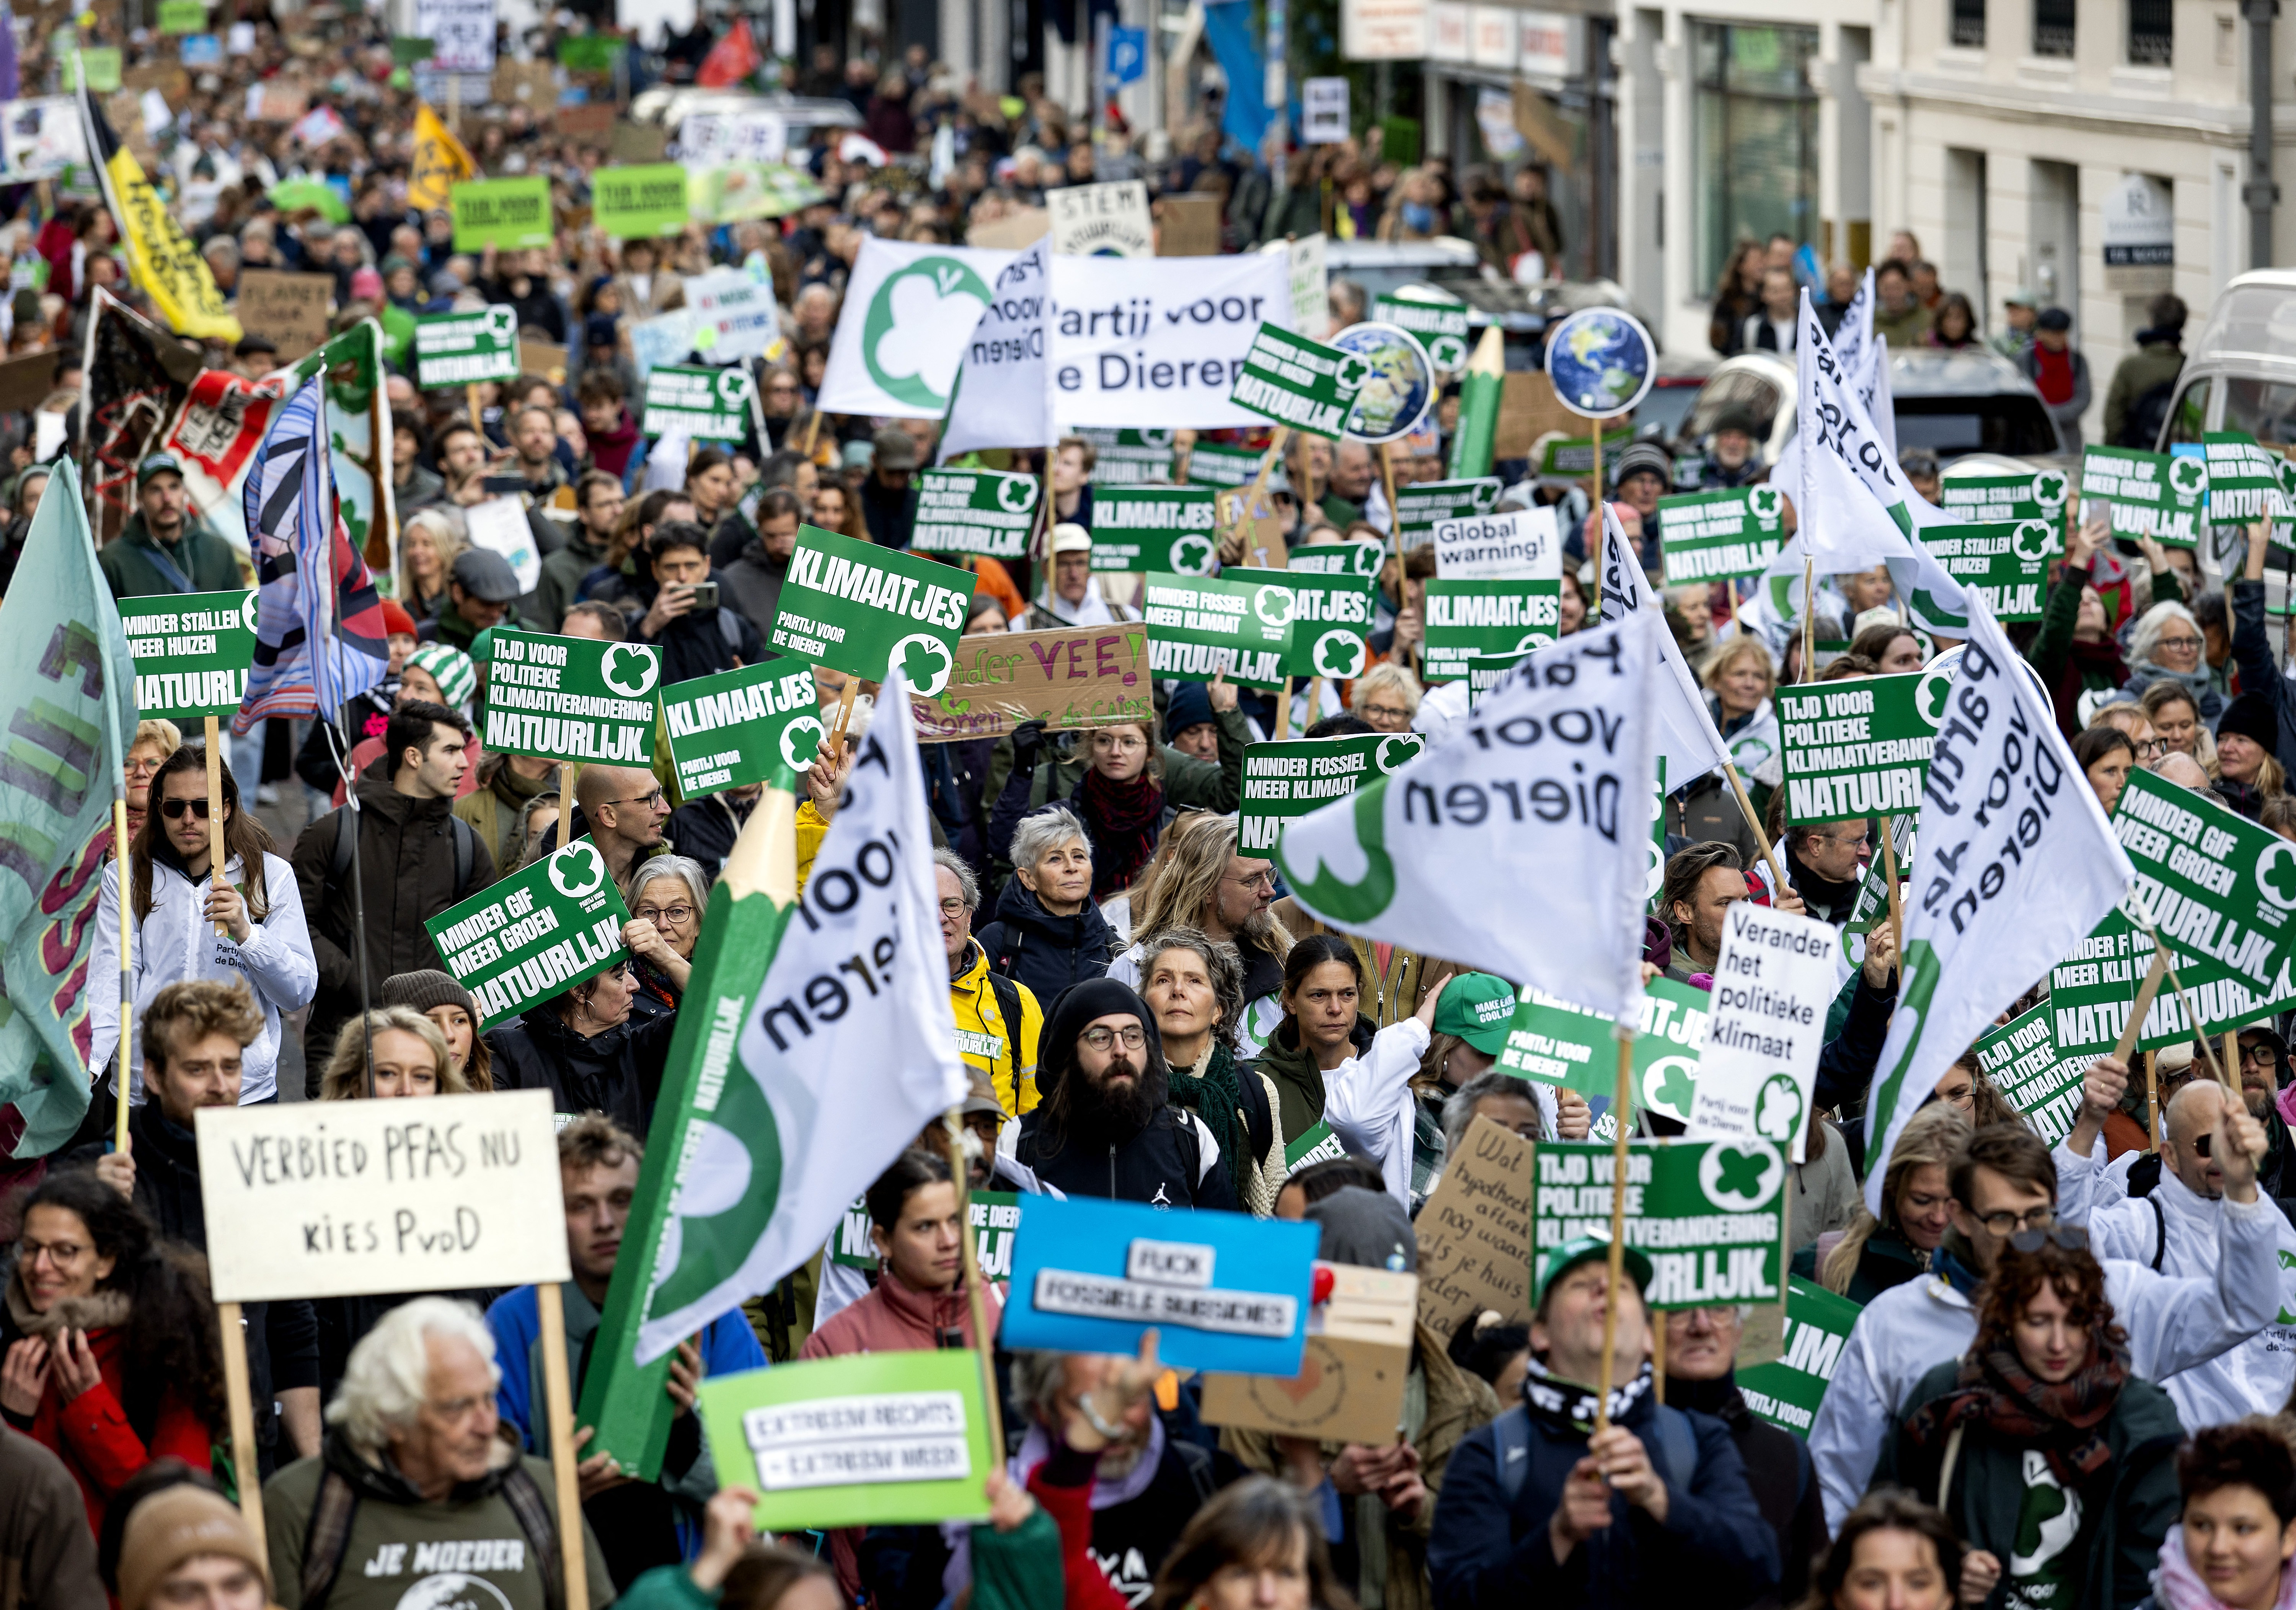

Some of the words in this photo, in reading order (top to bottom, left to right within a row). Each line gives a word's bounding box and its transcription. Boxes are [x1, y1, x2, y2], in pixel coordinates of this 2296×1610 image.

[1051, 298, 1151, 336] artij
[1166, 294, 1265, 324] voor
[1233, 371, 1346, 436] NATUURLIJK.
[2085, 455, 2134, 478] MINDER
[2135, 460, 2156, 481] GIF
[1944, 488, 1987, 505] MINDER
[2083, 473, 2119, 498] MEER
[2120, 479, 2161, 501] GROEN
[1092, 501, 1215, 530] KLIMAATJES
[1660, 505, 1702, 524] MINDER
[912, 524, 1026, 556] NATUURLIJK.
[1439, 518, 1517, 543] Global
[1663, 522, 1694, 542] MEER
[1963, 535, 2011, 554] STALLEN
[1442, 535, 1545, 564] warning!
[1950, 557, 1989, 574] HUIZEN
[788, 546, 968, 630] KLIMAATJES
[1147, 586, 1198, 608] MINDER
[1199, 592, 1249, 615] FOSSIEL
[1145, 606, 1183, 628] MEER
[1184, 610, 1241, 635] KLIMAAT
[1295, 590, 1366, 622] ATJES
[1427, 595, 1557, 626] KLIMAATJES
[122, 613, 178, 636] MINDER
[181, 610, 239, 633] STALLEN
[777, 611, 815, 635] PARTIJ
[817, 623, 845, 643] VOOR
[127, 638, 165, 658] MEER
[168, 635, 216, 656] HUIZEN
[493, 638, 524, 661] TIJD
[528, 642, 566, 666] VOOR
[772, 630, 787, 646] DE
[788, 633, 826, 657] DIEREN
[1427, 648, 1455, 661] PARTIJ
[1029, 633, 1145, 686] VEE!
[1148, 639, 1284, 683] NATUURLIJK.
[1427, 663, 1437, 675] DE
[491, 661, 561, 689] POLITIEKE
[489, 685, 652, 722] KLIMAATVERANDERING
[667, 671, 816, 737] KLIMAATJES
[1061, 703, 1083, 727] de
[1781, 696, 1821, 721] TIJD
[1825, 690, 1874, 717] VOOR
[486, 711, 650, 762] NATUURLIJK.
[1784, 717, 1870, 747] POLITIEKE
[680, 756, 712, 776] PARTIJ
[715, 749, 740, 767] VOOR
[1247, 757, 1307, 776] MINDER
[1311, 753, 1367, 776] FOSSIEL
[1786, 737, 1936, 773] KLIMAATVERAND
[684, 775, 696, 792] DE
[698, 768, 731, 788] DIEREN
[1246, 780, 1288, 799] MEER
[1293, 775, 1358, 799] KLIMAAT
[1789, 767, 1923, 819] NATUURL
[2120, 784, 2203, 846] MINDER
[2200, 825, 2239, 861] GIF
[2112, 813, 2171, 863] MEER
[2168, 843, 2237, 897] GROEN
[579, 896, 595, 909] PARTIJ
[594, 891, 606, 903] VOOR
[585, 905, 594, 913] DE
[592, 899, 606, 911] DIEREN
[436, 902, 509, 956] MINDER
[505, 886, 534, 919] GIF
[1733, 912, 1832, 959] Verander
[2122, 872, 2277, 987] TUURLIJK.
[217, 944, 238, 956] Partij
[448, 940, 502, 980] MEER
[498, 905, 560, 953] GROEN
[215, 956, 226, 965] de
[468, 913, 627, 1020] NATUURLIJK
[1725, 946, 1761, 977] het
[2054, 964, 2098, 989] MEER
[1475, 1000, 1499, 1013] MAKE
[1479, 1011, 1501, 1023] COOL
[1718, 986, 1813, 1025] politieke
[951, 1029, 967, 1038] PARTIJ
[968, 1031, 980, 1041] VOOR
[987, 1036, 1002, 1045] DIEREN
[954, 1037, 1000, 1058] TUURLIJK.
[1507, 1030, 1554, 1057] PARTIJ
[1554, 1040, 1592, 1064] VOOR
[1712, 1018, 1793, 1060] klimaat
[1978, 1041, 2011, 1072] TIJD
[2009, 1017, 2050, 1055] VOOR
[693, 995, 745, 1112] NATUURLIJK.
[1501, 1049, 1521, 1066] DE
[1523, 1055, 1567, 1079] DIEREN
[1990, 1041, 2056, 1090] POLITIEKE
[1699, 1095, 1725, 1117] Partij
[1726, 1104, 1749, 1118] voor
[1696, 1114, 1709, 1127] de
[1712, 1115, 1743, 1133] Dieren
[385, 1123, 465, 1182] PFAS
[481, 1130, 520, 1168] NU
[1476, 1129, 1523, 1173] Wat
[1538, 1153, 1587, 1184] TIJD
[1592, 1154, 1652, 1184] VOOR
[969, 1204, 987, 1226] DE
[989, 1205, 1021, 1228] DIER
[1440, 1207, 1473, 1241] nog
[1459, 1251, 1477, 1275] je
[1481, 1261, 1523, 1298] huis
[2266, 1341, 2279, 1351] de
[1776, 1401, 1812, 1427] VOOR
[366, 1543, 408, 1576] JE
[415, 1538, 525, 1572] MOEDER
